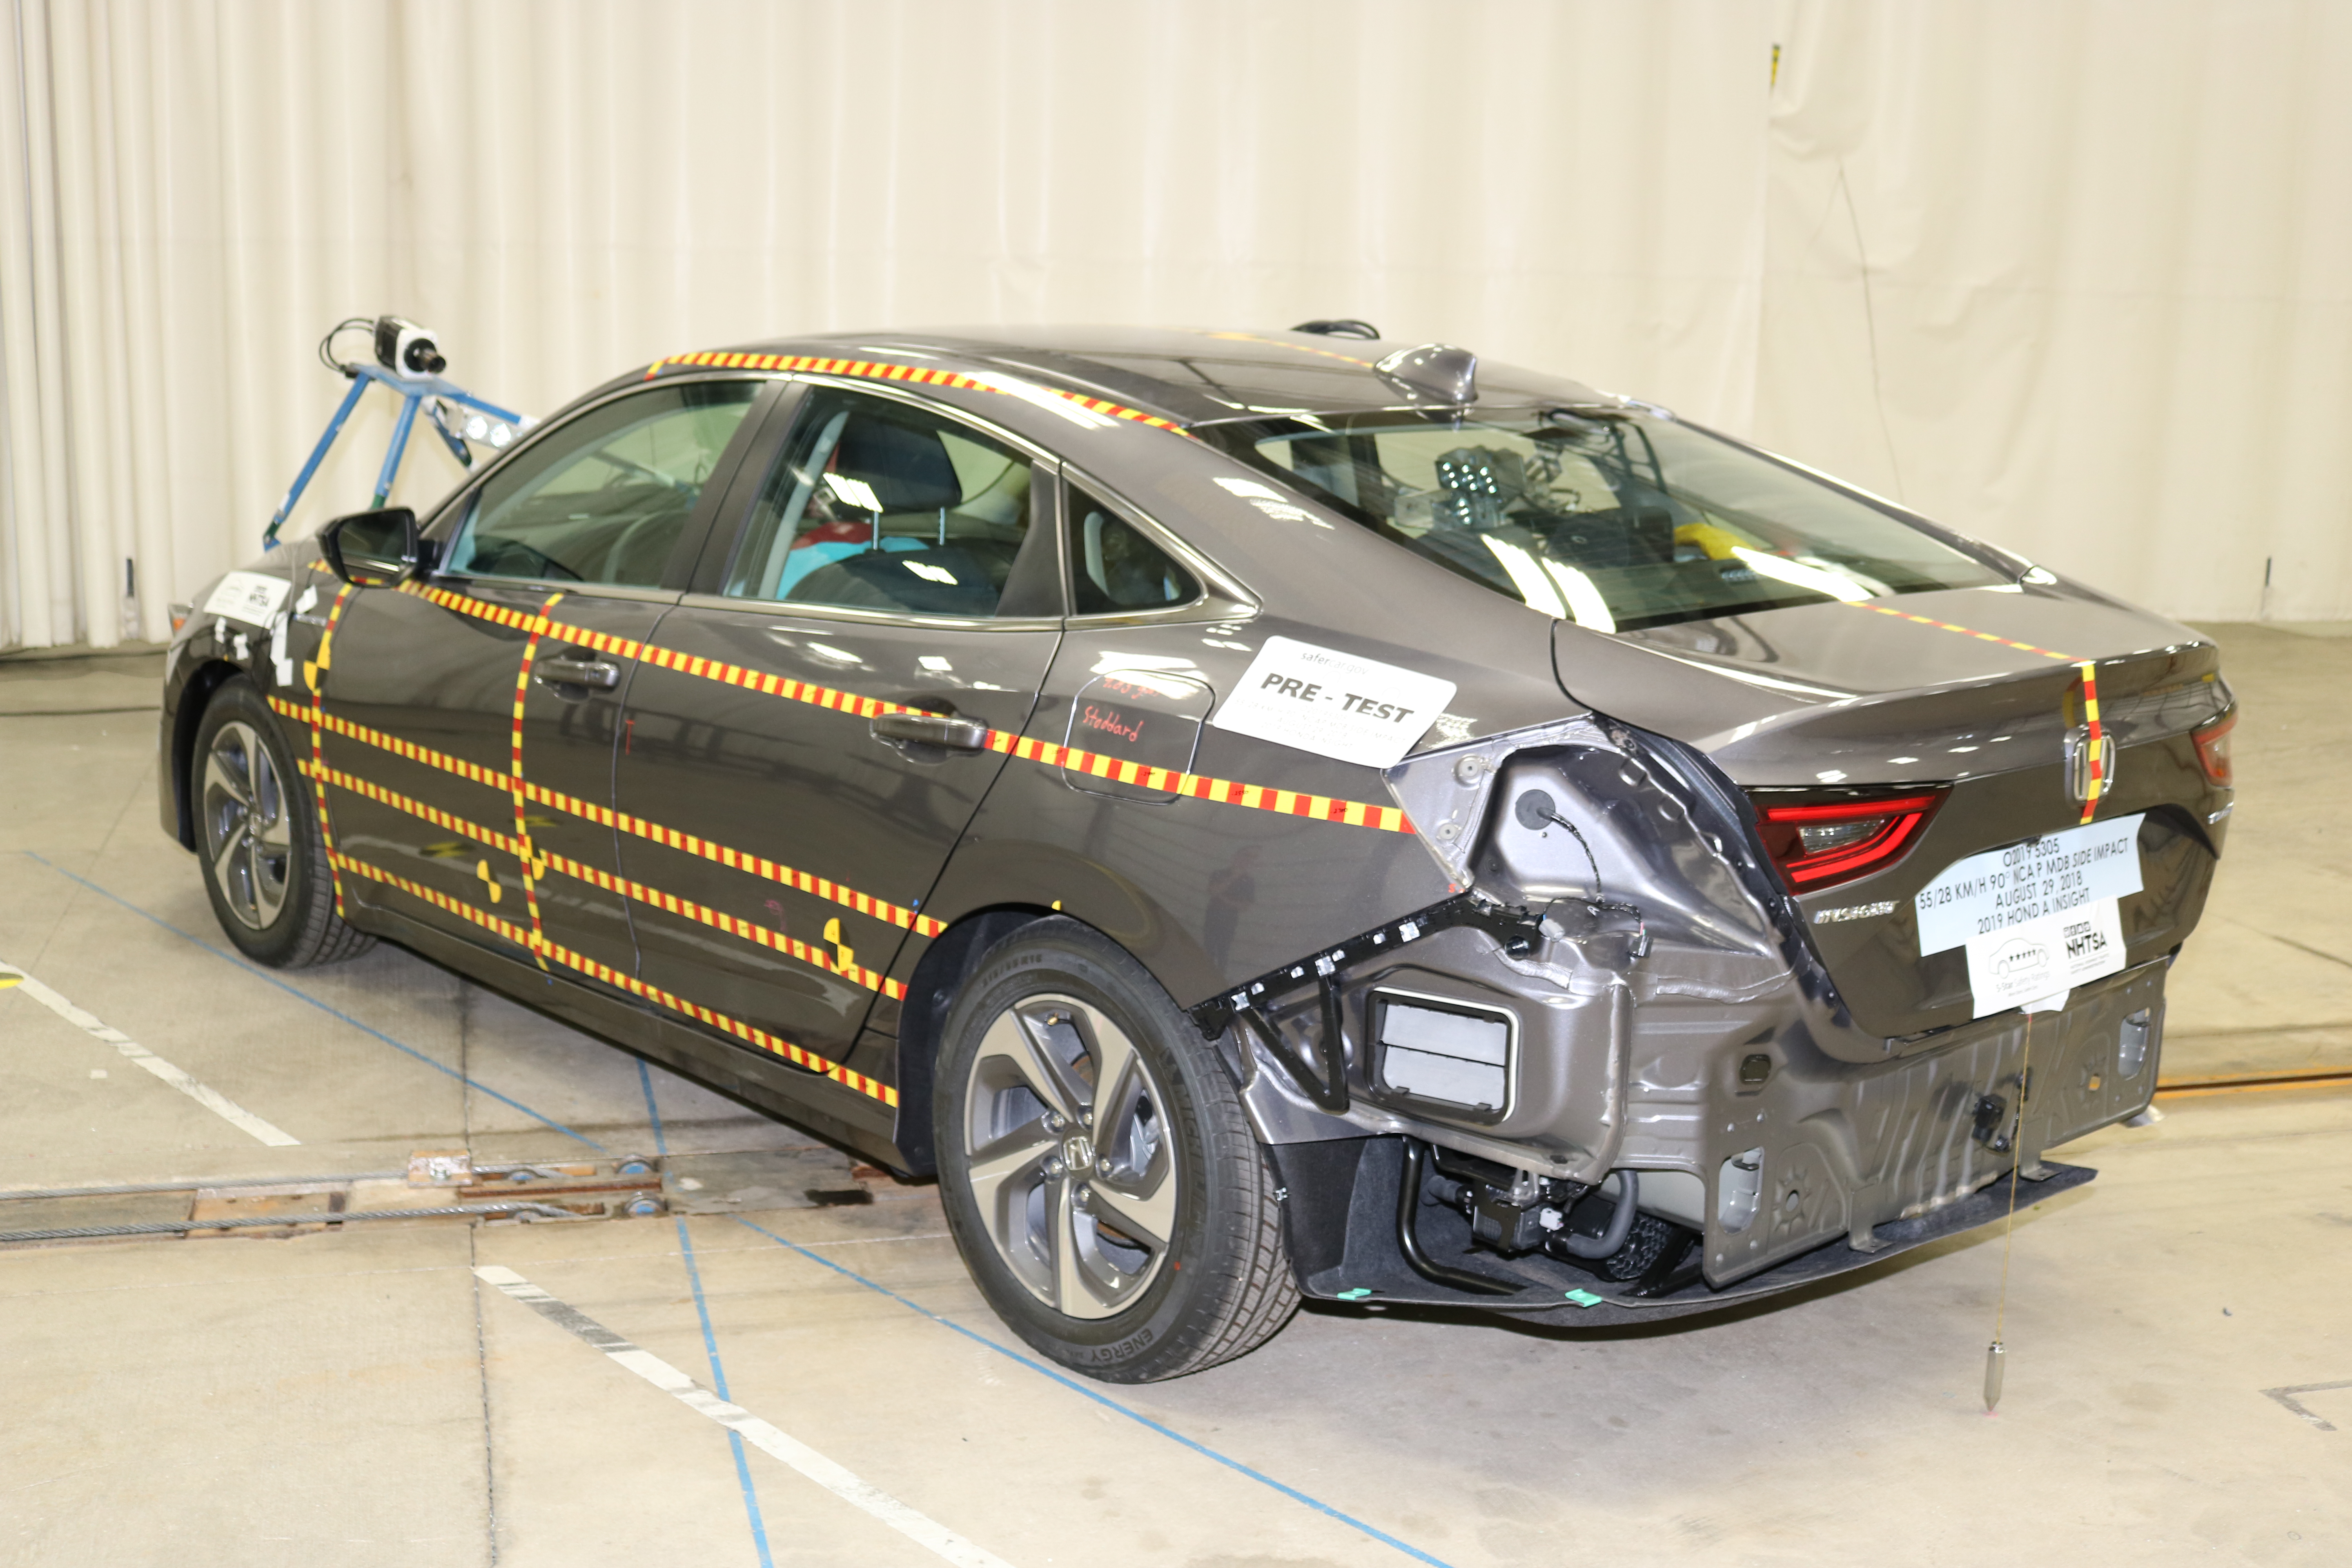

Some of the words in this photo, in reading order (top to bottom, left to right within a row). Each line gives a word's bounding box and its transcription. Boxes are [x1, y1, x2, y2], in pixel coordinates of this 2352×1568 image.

[1300, 652, 1369, 675] safercar.gov
[1259, 672, 1322, 703] PRE
[1341, 693, 1415, 724] TEST
[1919, 886, 1952, 910] 55/28
[1955, 877, 1987, 900] KM/H
[2046, 855, 2070, 876] MDB
[2072, 848, 2092, 868] SIDE
[2094, 837, 2129, 862] IMPACT
[1995, 882, 2037, 910] AUGUST
[2060, 870, 2083, 891] 2018
[1977, 913, 2003, 935] 2019
[2053, 887, 2090, 913] INSIGHT
[2065, 930, 2108, 959] NHTSA
[1091, 1328, 1153, 1362] ENERGY
